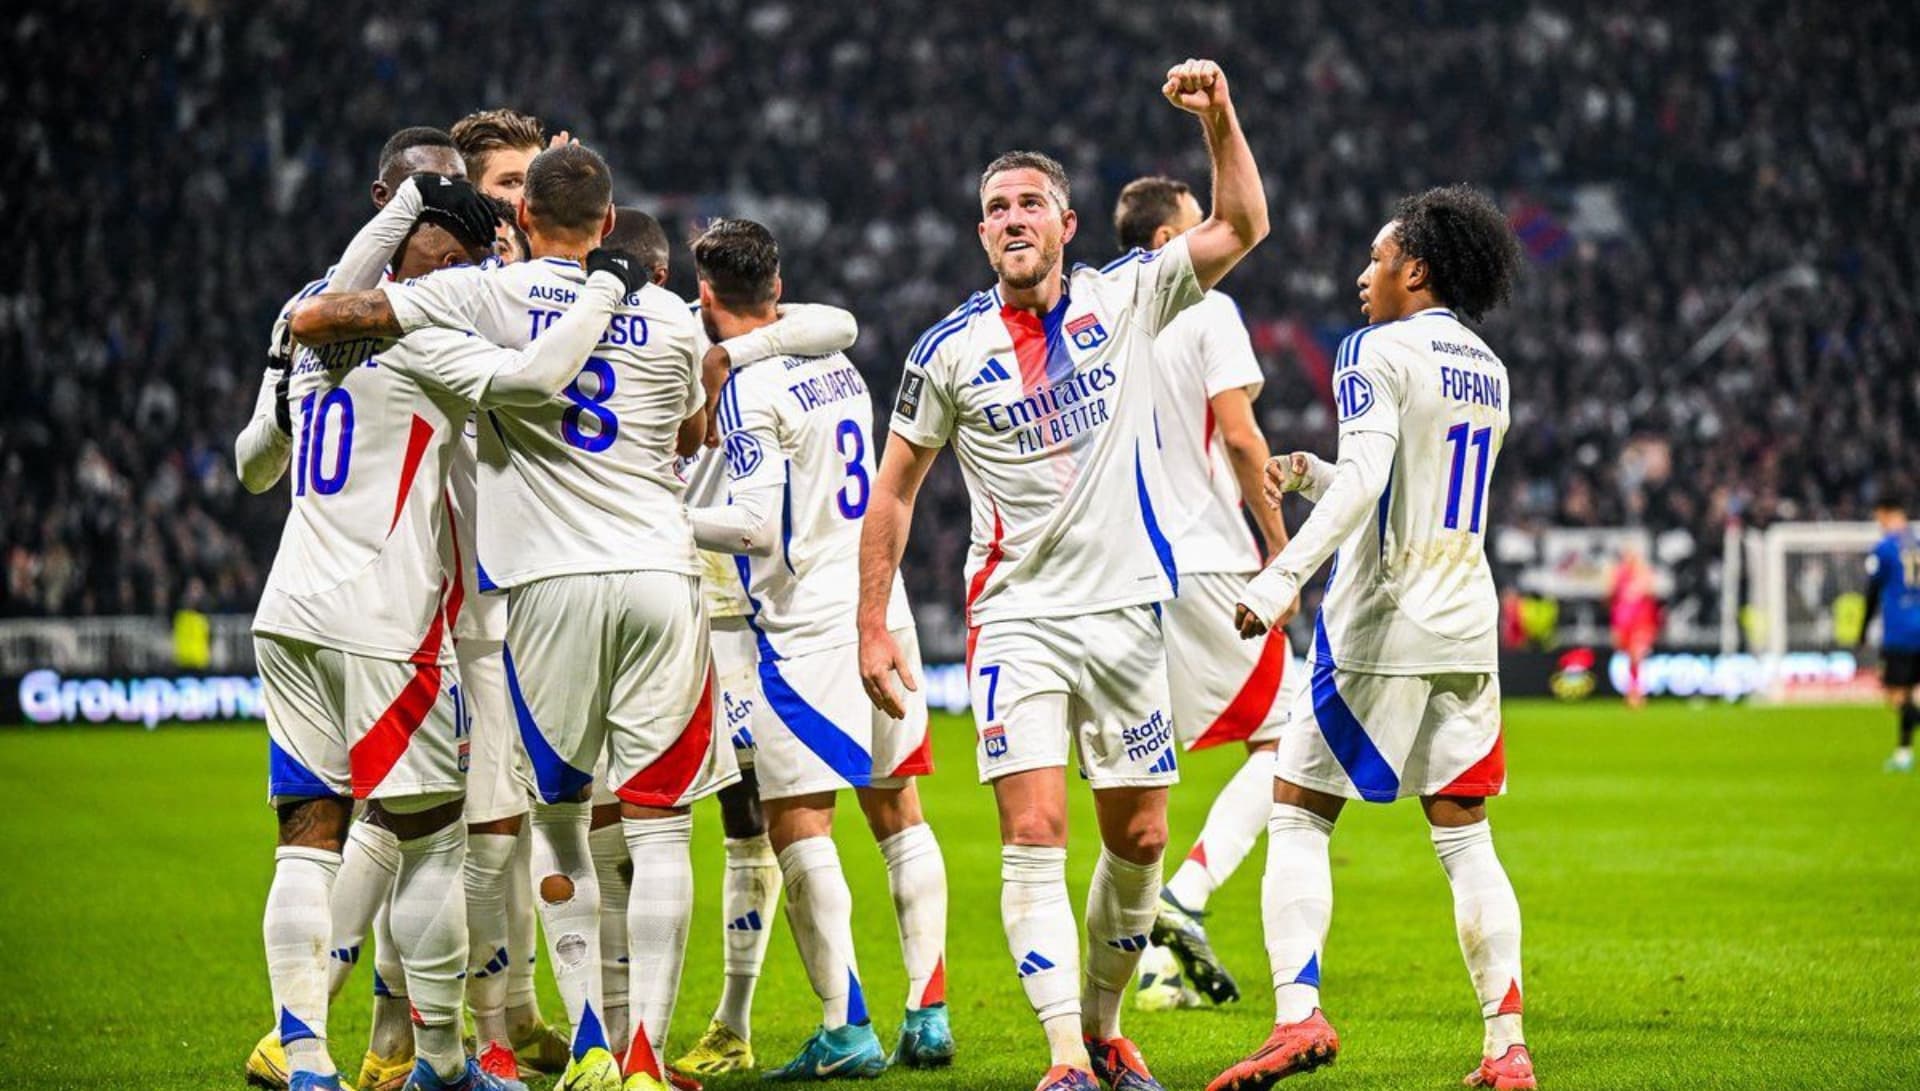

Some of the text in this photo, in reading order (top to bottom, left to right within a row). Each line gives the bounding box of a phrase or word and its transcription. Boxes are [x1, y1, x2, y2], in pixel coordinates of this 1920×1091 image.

[561, 356, 619, 453] 8
[982, 362, 1116, 432] Emirates
[1441, 366, 1502, 412] FOFANA
[296, 386, 355, 497] 10
[1017, 398, 1109, 455] FLY BETTER
[836, 418, 870, 520] 3
[1443, 421, 1492, 535] 11
[979, 665, 1001, 722] 7
[1122, 709, 1164, 745] Staff
